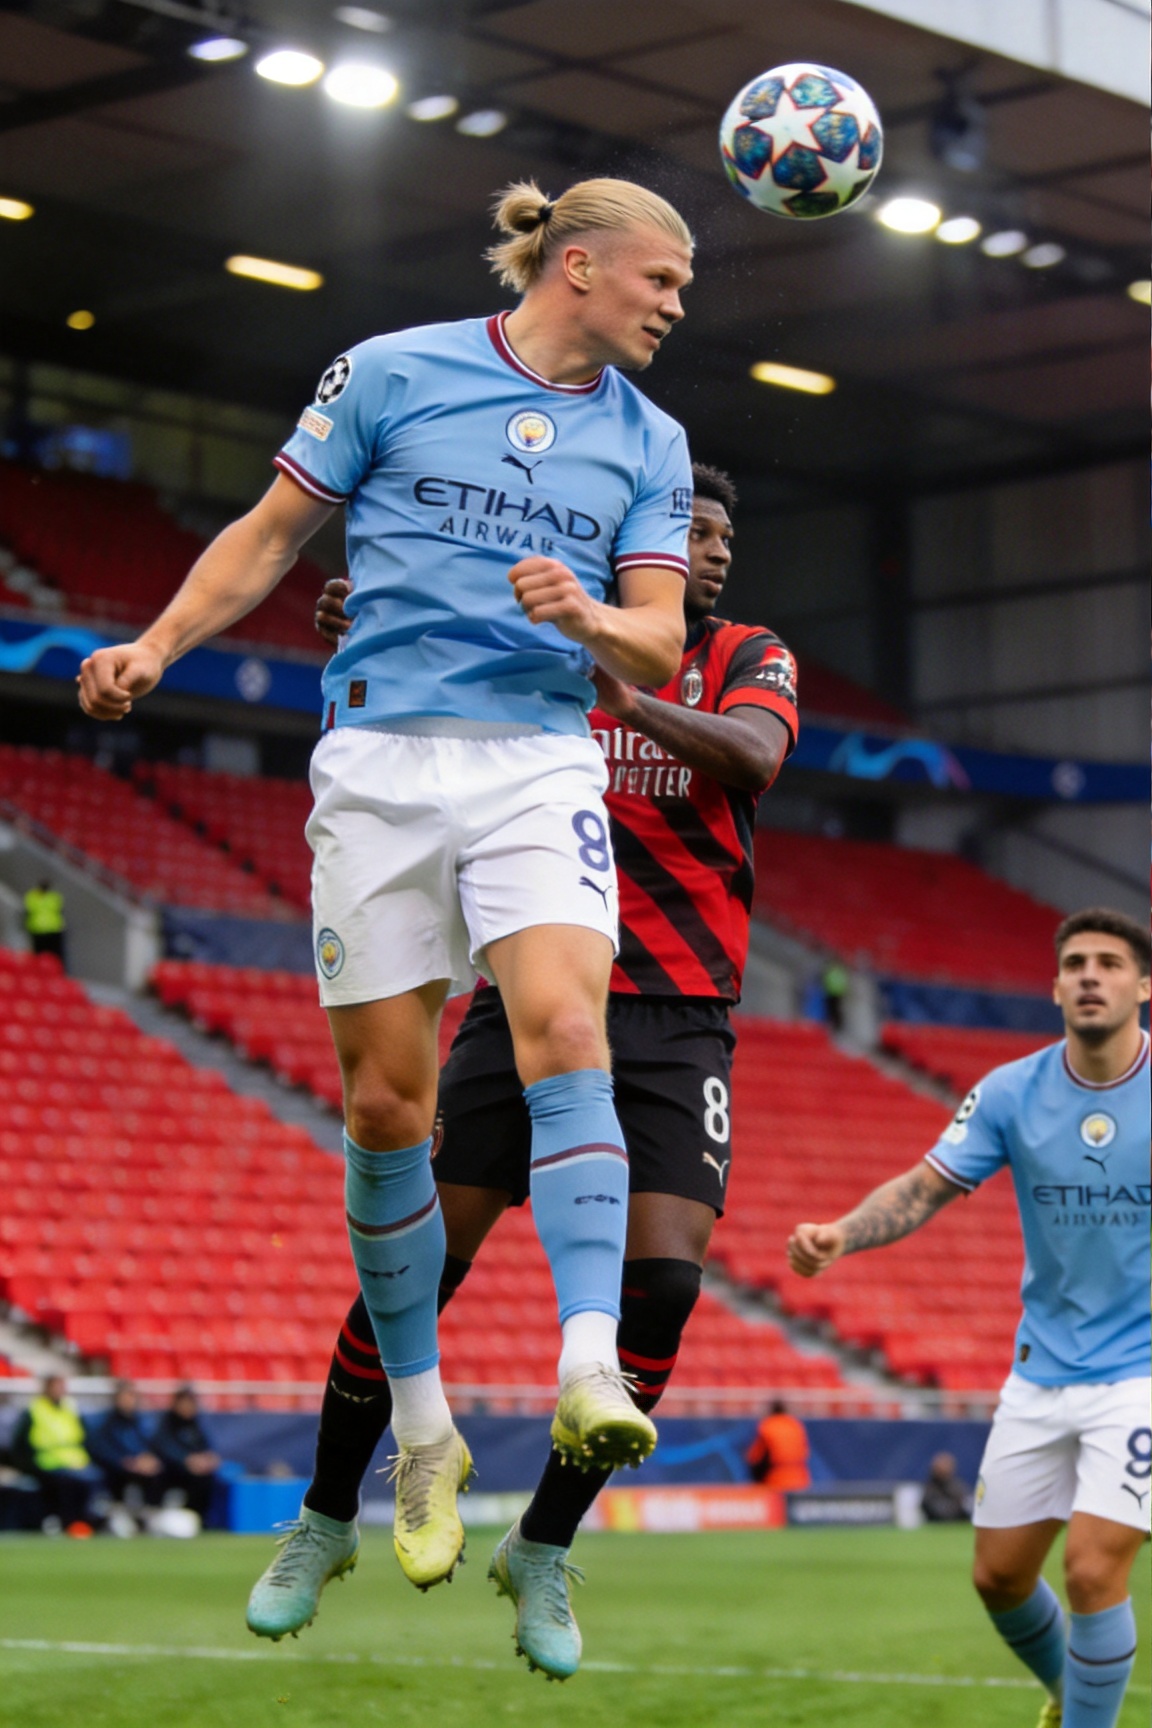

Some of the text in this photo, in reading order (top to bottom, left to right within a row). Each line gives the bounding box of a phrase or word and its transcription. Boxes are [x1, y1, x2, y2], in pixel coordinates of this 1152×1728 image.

[413, 477, 601, 541] ETIHAD
[572, 809, 610, 872] 8
[702, 1076, 729, 1143] 8
